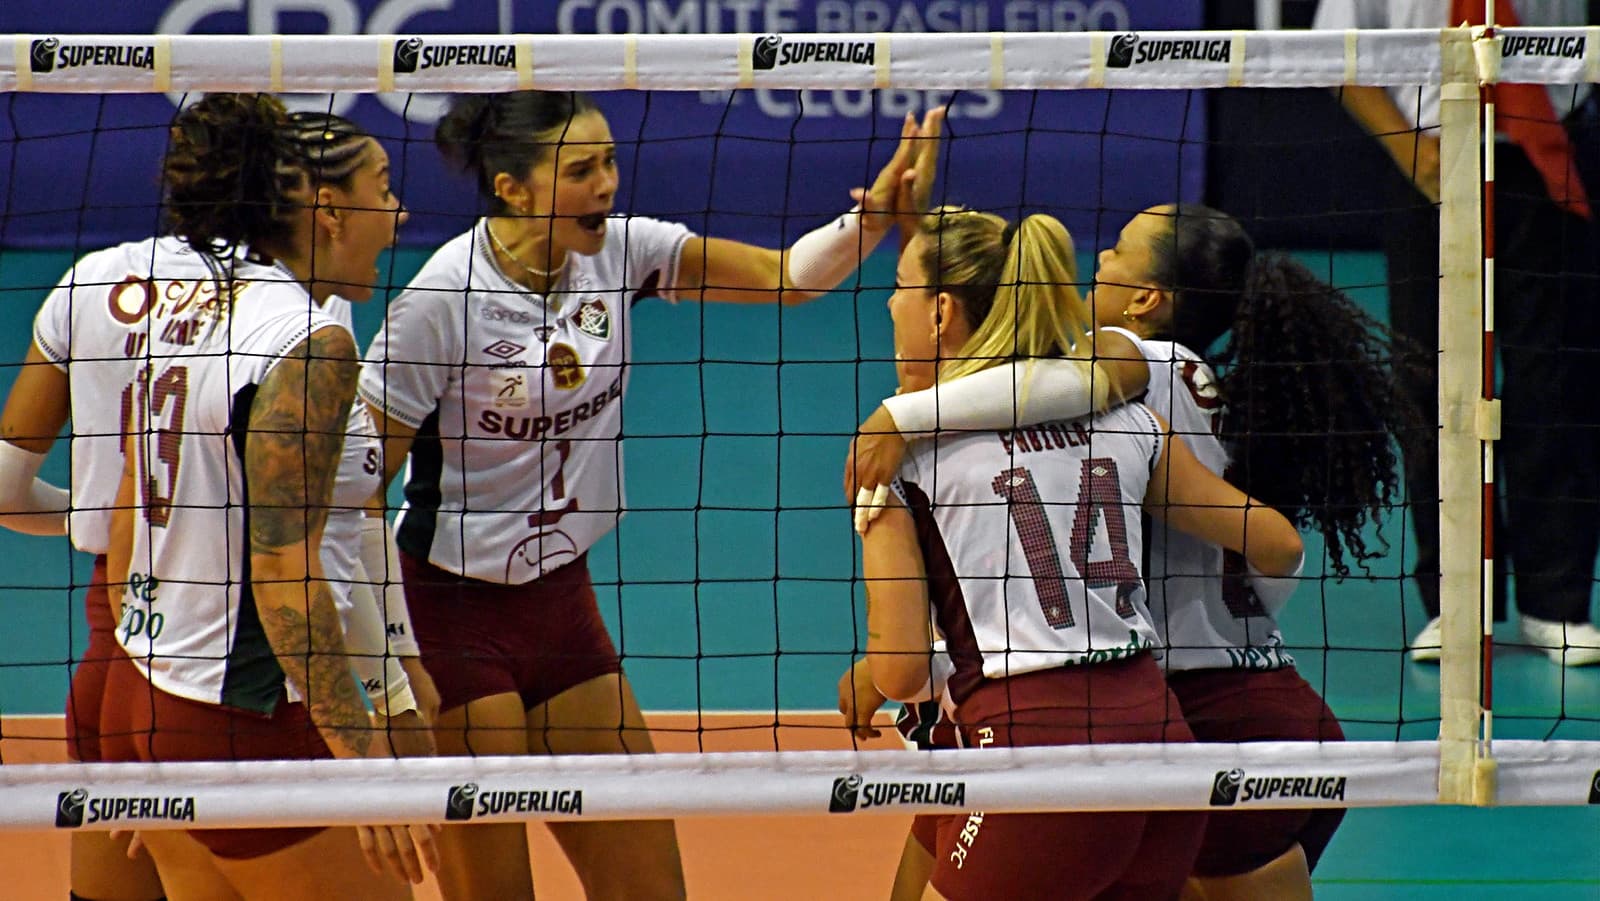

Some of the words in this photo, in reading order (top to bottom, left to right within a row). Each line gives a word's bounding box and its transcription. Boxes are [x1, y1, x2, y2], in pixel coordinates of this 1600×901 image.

[57, 45, 155, 70] SUPERLIGA
[420, 45, 516, 69] SUPERLIGA
[779, 42, 875, 66] SUPERLIGA
[1135, 40, 1231, 64] SUPERLIGA
[991, 457, 1142, 630] 14
[860, 782, 966, 807] SUPERLIGA
[1240, 777, 1347, 803] SUPERLIGA
[87, 797, 195, 823] SUPERLIGA
[476, 791, 583, 816] SUPERLIGA
